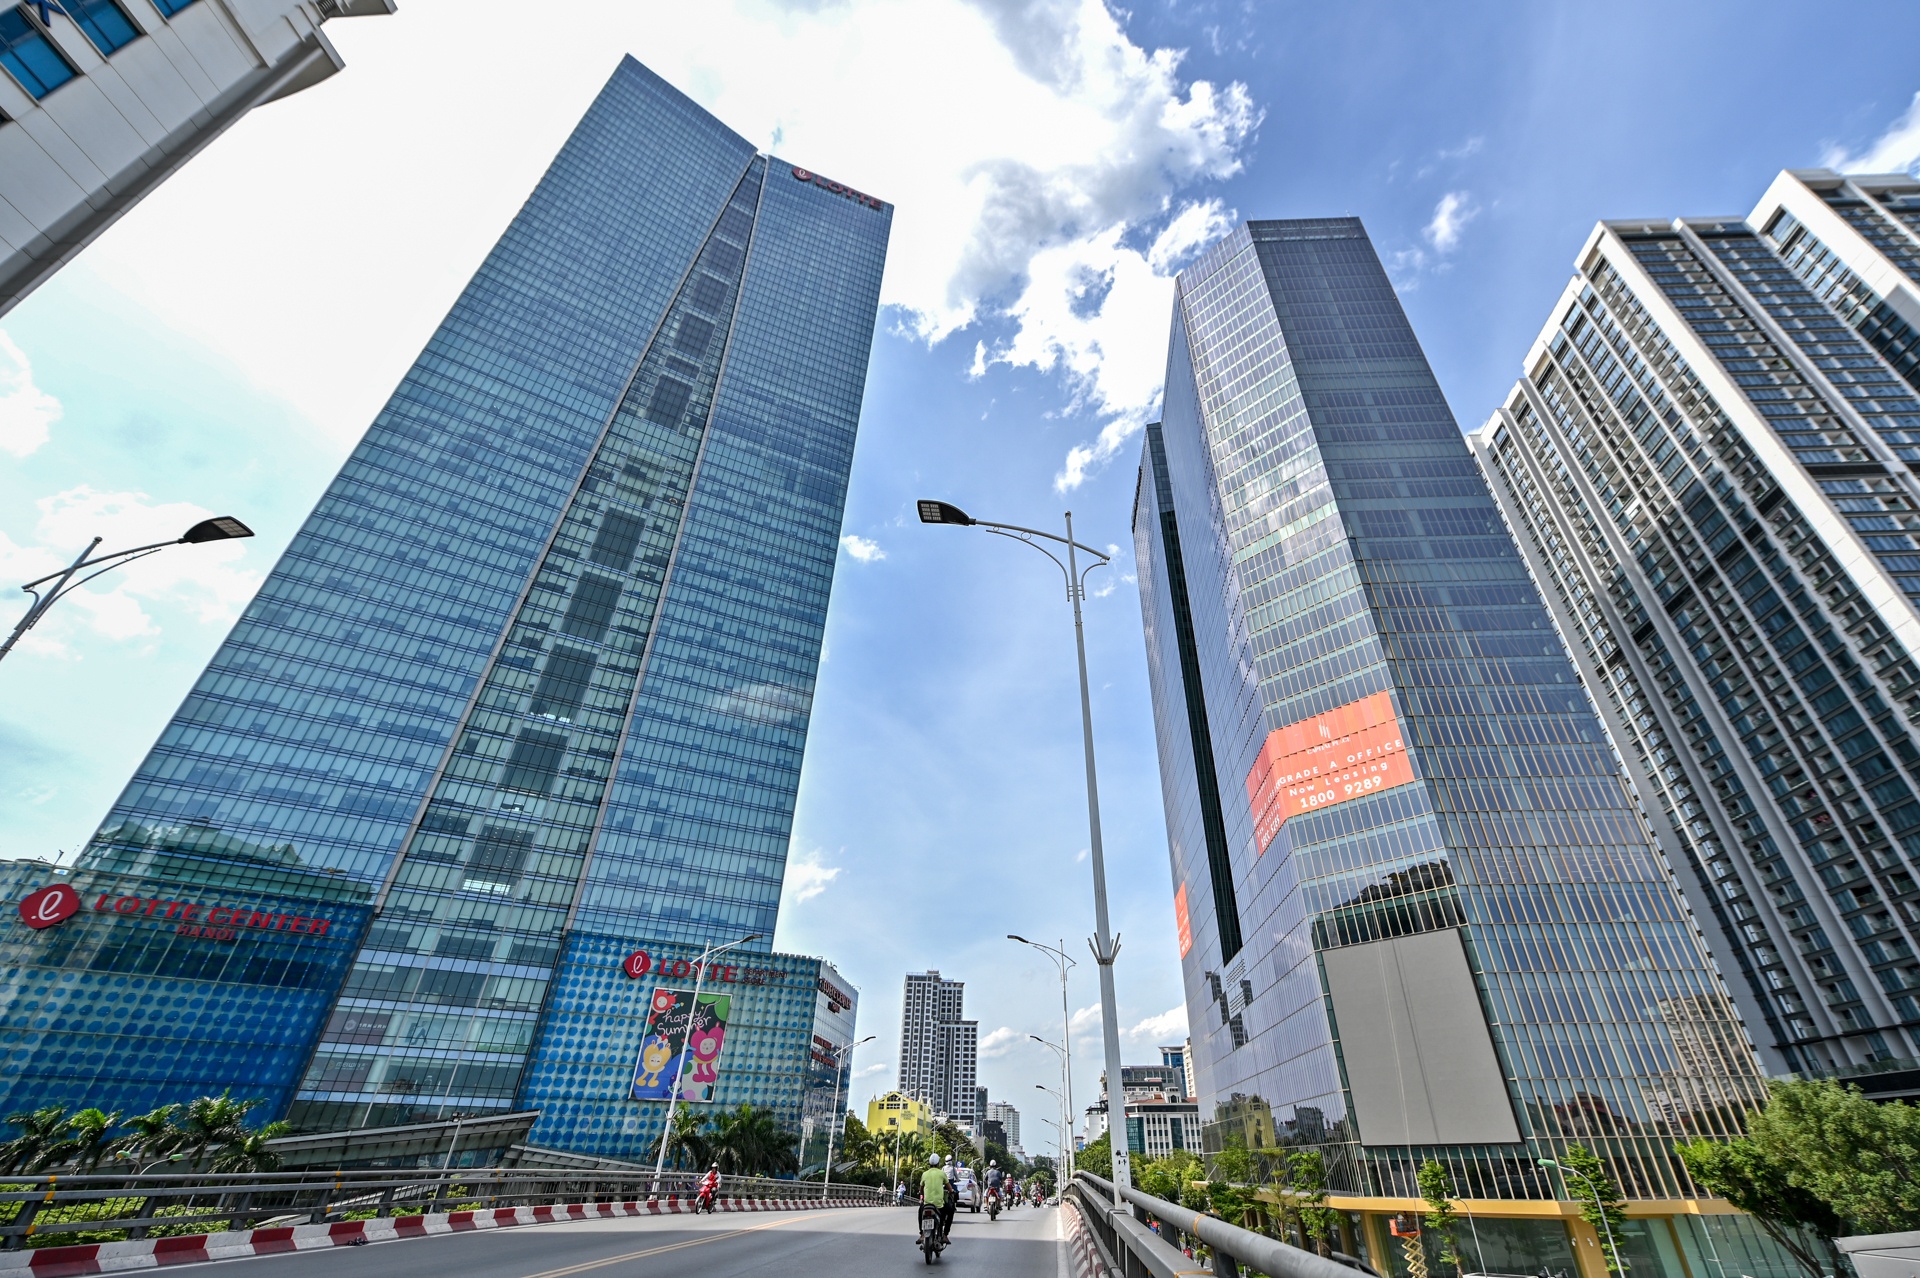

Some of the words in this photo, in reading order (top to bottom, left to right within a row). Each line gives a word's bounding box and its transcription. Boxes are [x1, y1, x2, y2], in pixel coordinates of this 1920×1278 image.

[816, 177, 882, 210] LOTTE
[1279, 766, 1319, 785] GRADE
[1330, 761, 1338, 769] A
[1347, 739, 1402, 763] OFFICE
[1289, 784, 1315, 797] Now
[1325, 761, 1389, 786] Leasing
[1300, 789, 1335, 808] 1800
[1344, 775, 1382, 795] 9289
[94, 893, 204, 921] LOTTE
[208, 907, 331, 935] CENTER
[175, 922, 237, 940] HANOI
